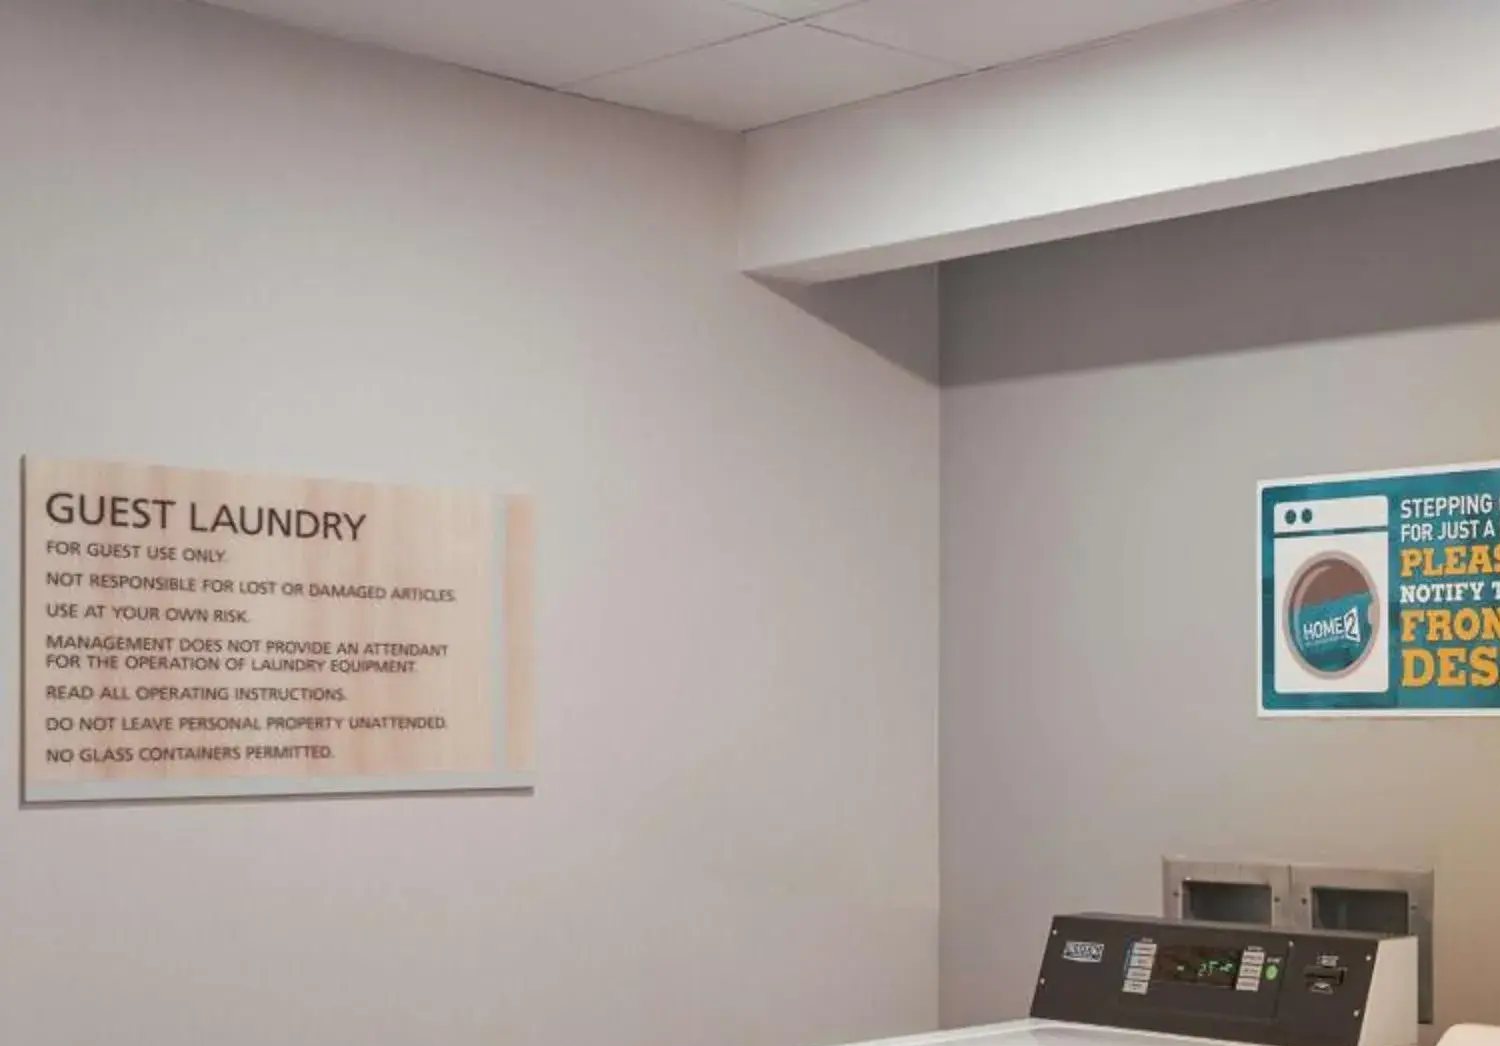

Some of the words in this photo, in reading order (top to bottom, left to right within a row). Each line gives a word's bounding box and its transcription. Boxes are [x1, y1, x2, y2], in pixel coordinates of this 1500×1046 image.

[1401, 492, 1493, 519] STEPPING
[46, 492, 177, 529] GUEST
[189, 502, 367, 541] LAUNDRY
[1401, 523, 1433, 543] FOR
[1437, 520, 1478, 540] JUST
[1483, 518, 1495, 536] A
[46, 541, 81, 556] FOR
[87, 543, 141, 559] GUEST
[147, 546, 177, 561] USE
[46, 572, 83, 587] NOT
[90, 573, 196, 592] RESPONSIBLE
[203, 579, 234, 593] FOR
[239, 580, 277, 595] LOST
[281, 583, 304, 596] OR
[309, 583, 386, 599] DAMAGED
[1400, 581, 1485, 604] NOTIFY
[46, 604, 78, 618] USE
[84, 605, 106, 619] AT
[112, 606, 160, 621] YOUR
[165, 607, 208, 622] OWN
[46, 635, 174, 651] MANAGEMENT
[179, 638, 222, 653] DOES
[227, 639, 261, 654] NOT
[267, 640, 332, 655] PROVIDE
[336, 642, 359, 655] AN
[363, 643, 449, 657] ATTENDANT
[46, 654, 81, 669] FOR
[87, 655, 119, 669] THE
[125, 656, 220, 671] OPERATION
[225, 657, 246, 671] OF
[251, 658, 326, 672] LAUNDRY
[46, 685, 94, 700] READ
[99, 686, 130, 700] ALL
[135, 686, 229, 701] OPERATING
[235, 687, 347, 701] INSTRUCTIONS.
[46, 717, 73, 731] DO
[79, 717, 116, 731] NOT
[122, 717, 173, 731] LEAVE
[179, 717, 261, 731] PERSONAL
[267, 716, 343, 730] PROPERTY
[46, 748, 74, 763] NO
[79, 747, 133, 762] GLASS
[138, 746, 241, 761] CONTAINERS
